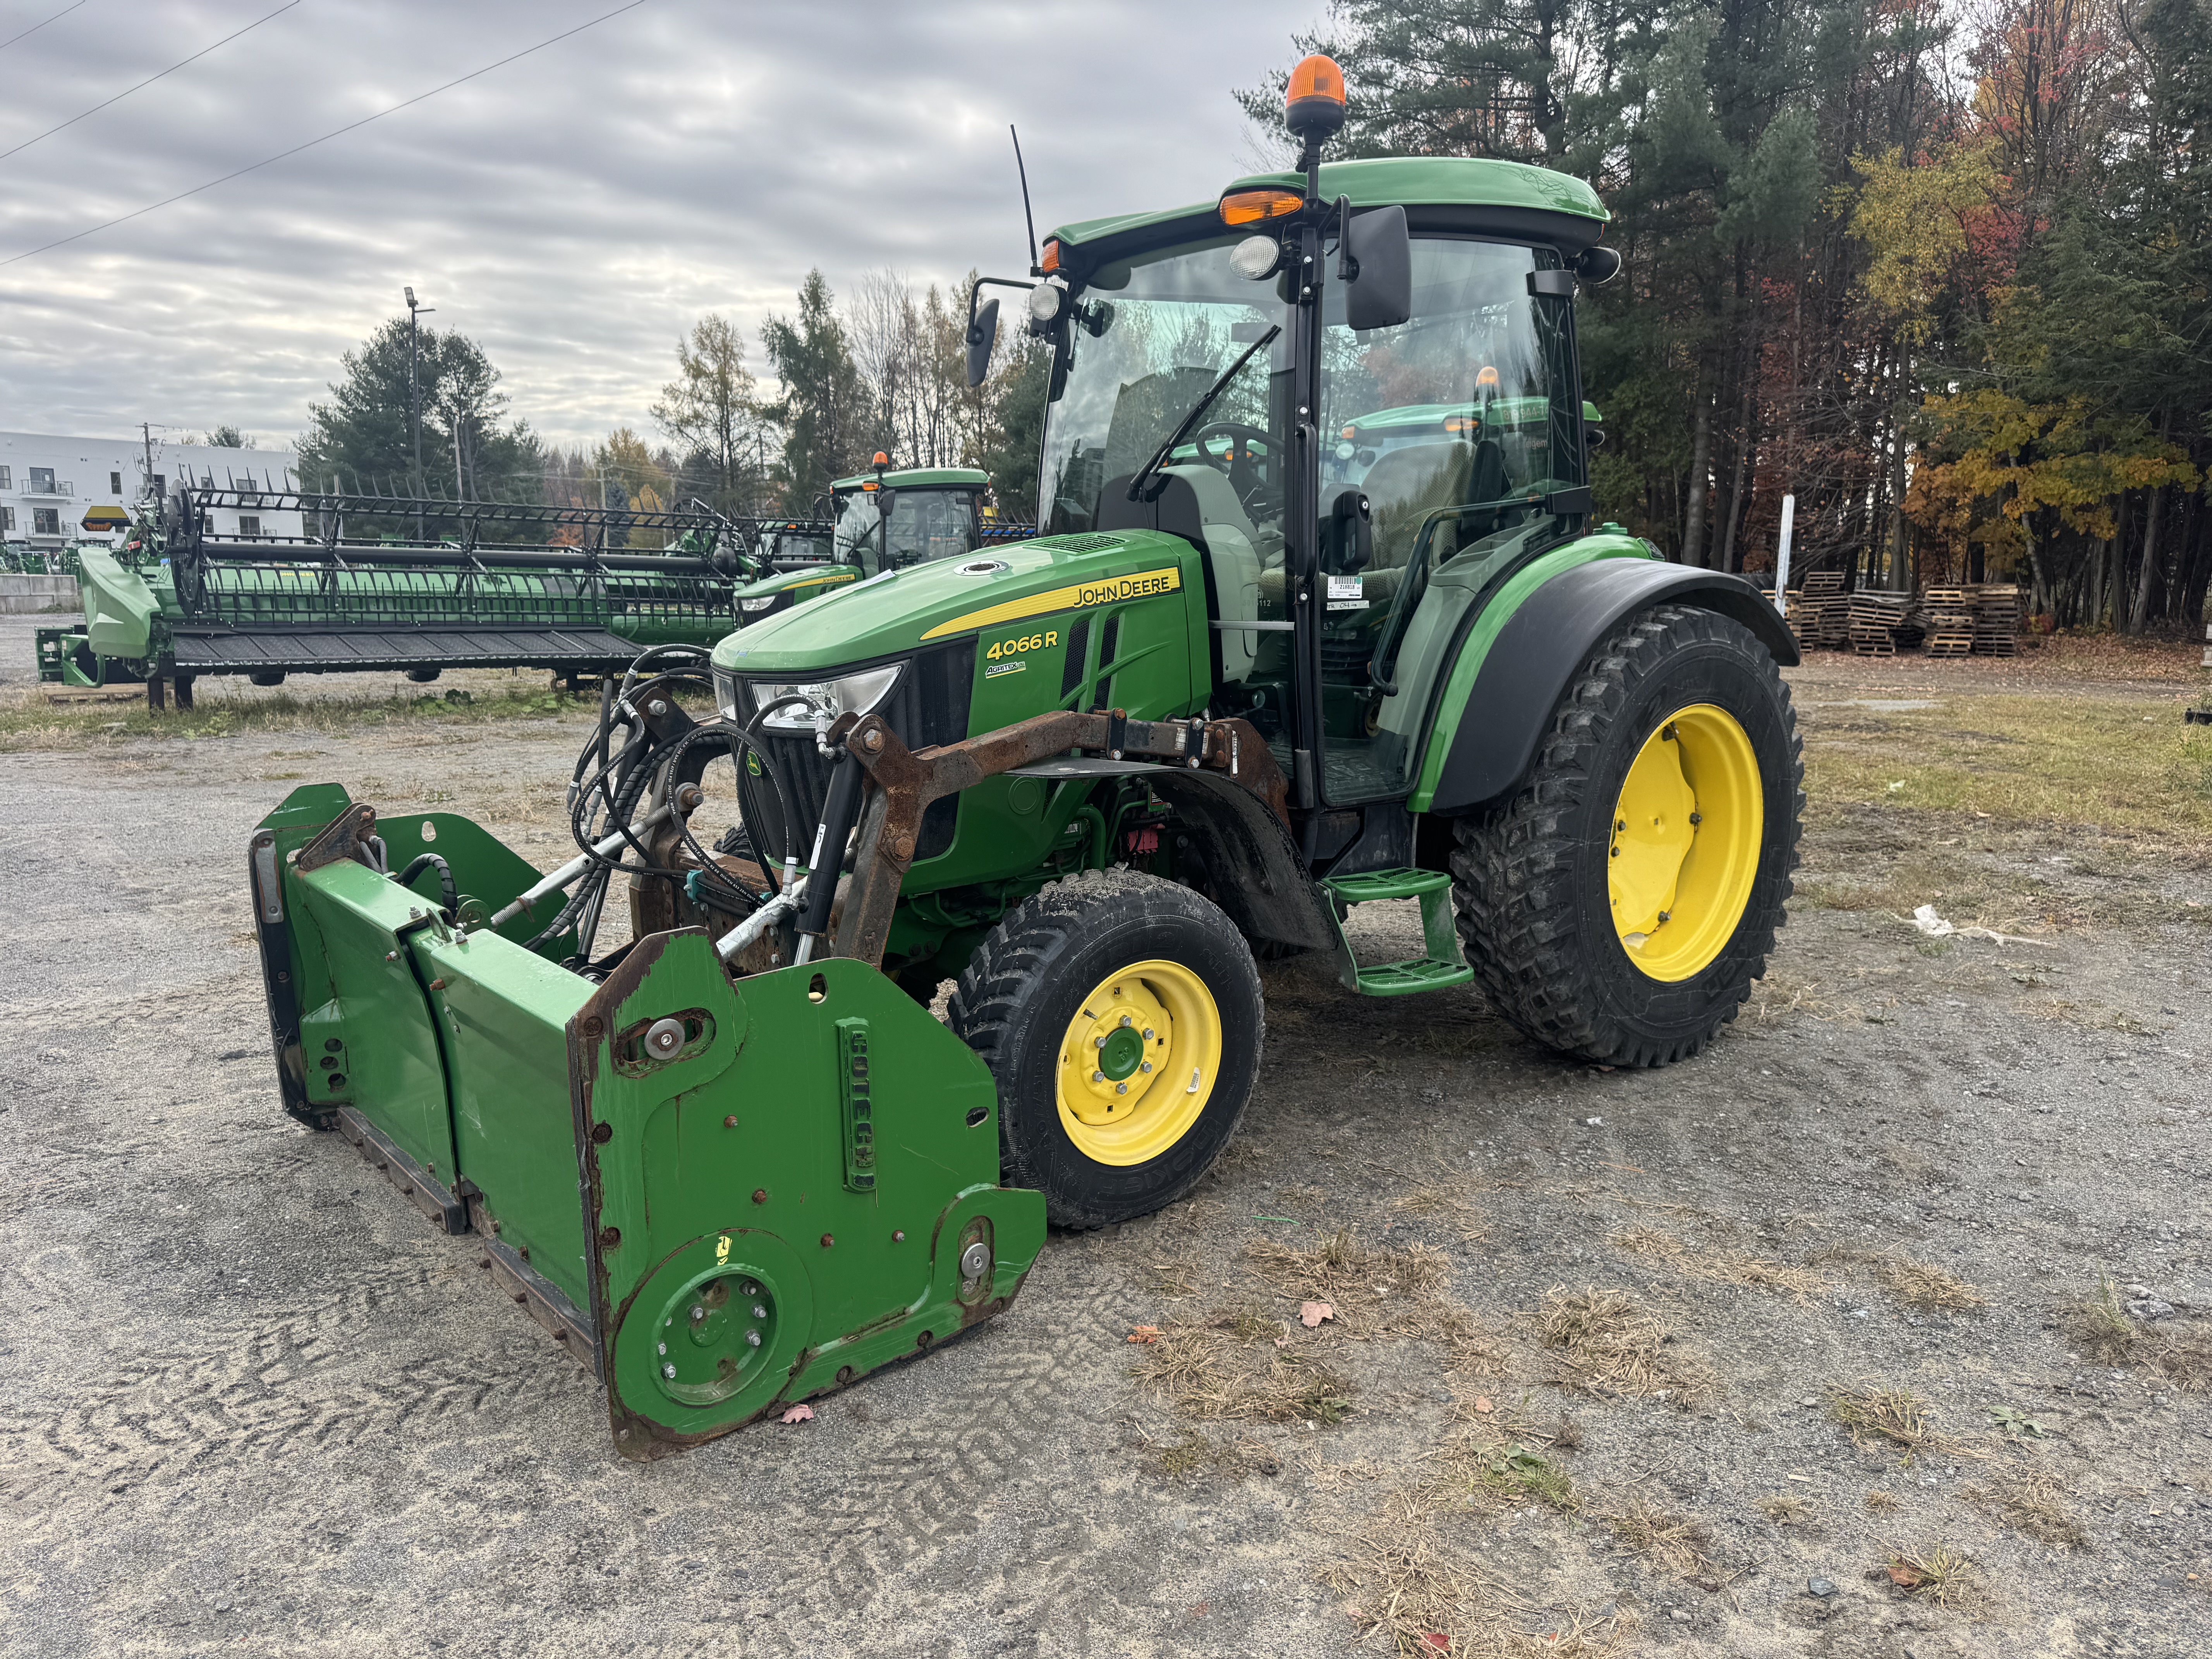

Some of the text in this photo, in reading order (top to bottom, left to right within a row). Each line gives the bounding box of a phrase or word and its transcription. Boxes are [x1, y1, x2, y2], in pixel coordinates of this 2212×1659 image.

[1073, 576, 1170, 606] JOHN DEERE
[986, 631, 1058, 660] 4066 R
[986, 663, 1018, 674] AGRITEX
[685, 835, 702, 857] TRANSFLEX
[1010, 1003, 1037, 1072] ROTATION
